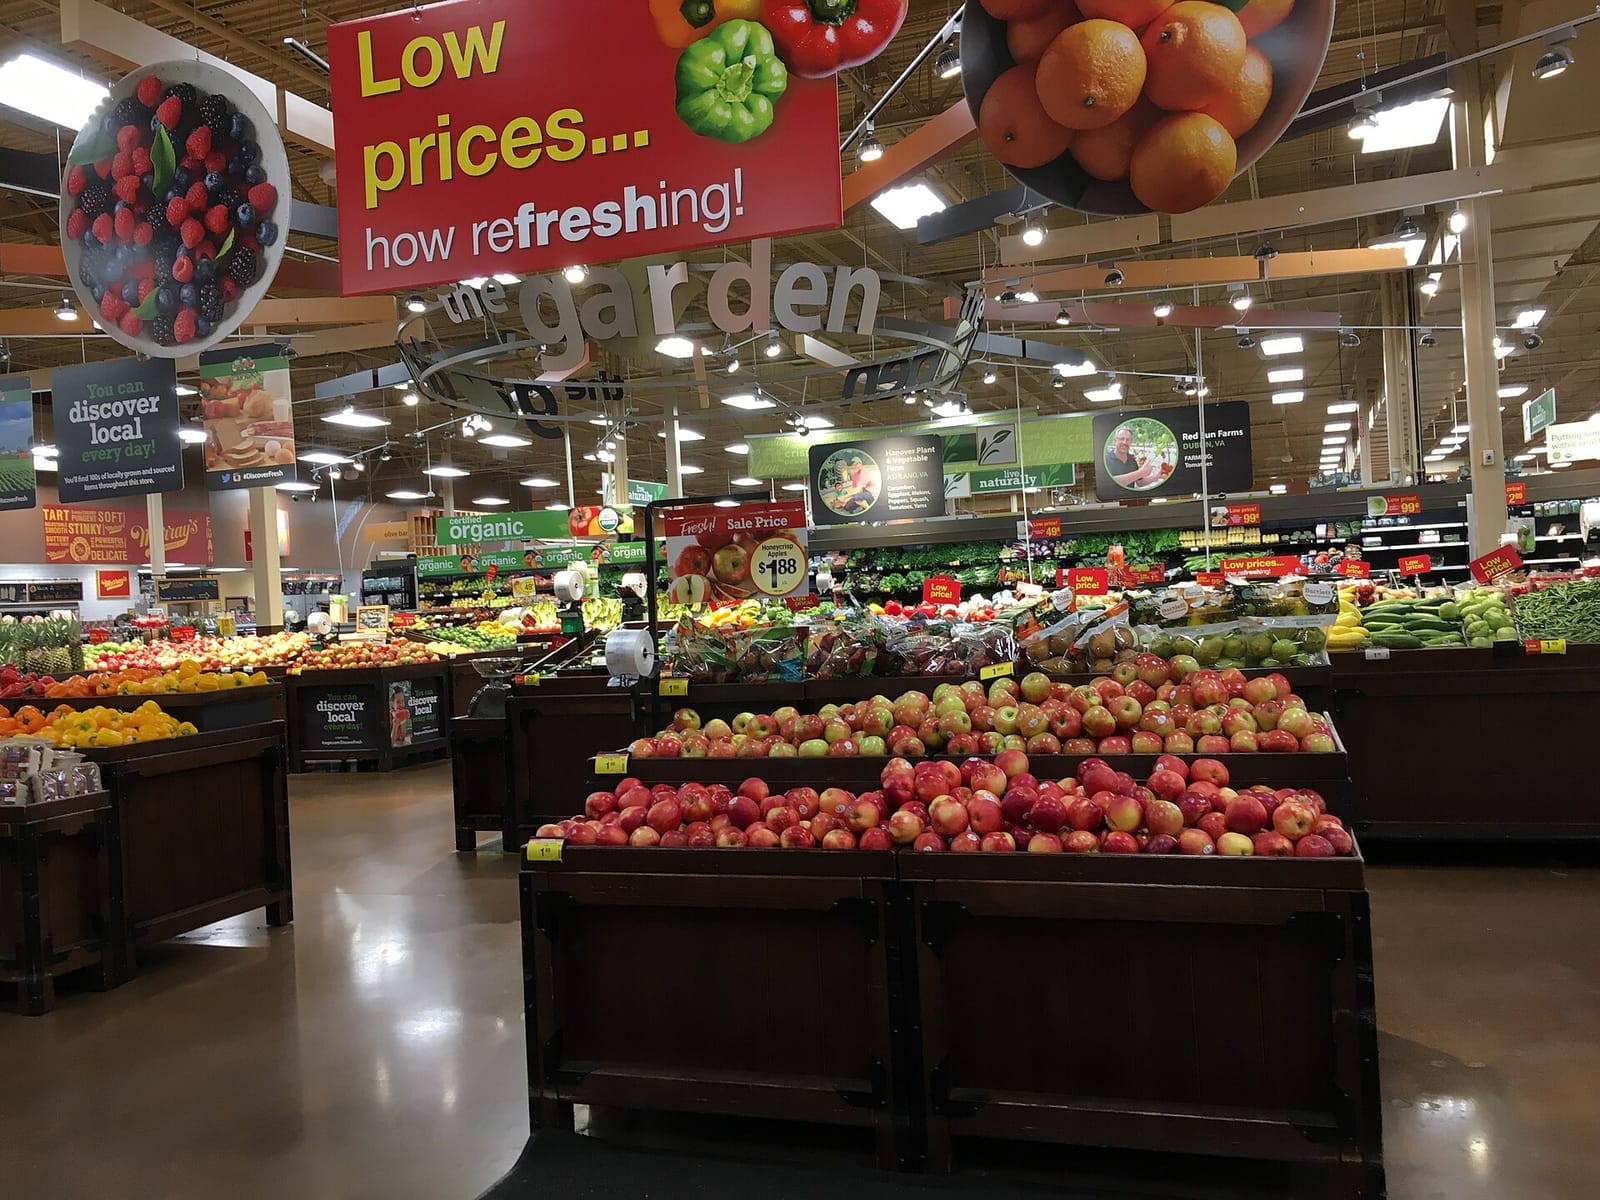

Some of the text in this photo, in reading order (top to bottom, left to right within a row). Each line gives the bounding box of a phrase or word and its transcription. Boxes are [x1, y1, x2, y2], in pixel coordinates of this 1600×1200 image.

[358, 20, 506, 98] Low
[363, 107, 650, 209] prices...
[365, 168, 745, 271] how refreshing!
[440, 238, 881, 372] the garden
[86, 381, 145, 399] You can
[69, 396, 160, 424] discover
[89, 417, 143, 445] local
[1182, 431, 1199, 441] Red
[1217, 429, 1244, 438] Farms
[81, 440, 156, 464] every day!
[885, 446, 936, 457] Hanover Plant
[892, 454, 928, 465] Vegetable
[142, 467, 153, 475] and
[919, 471, 929, 479] VA
[1003, 470, 1020, 478] live
[42, 508, 70, 521] TART
[97, 511, 123, 523] SOFT
[449, 516, 482, 526] certified
[680, 516, 788, 537] Fresh! Sale Price
[68, 523, 102, 535] STINKY
[384, 530, 398, 538] olive
[449, 517, 524, 542] organic
[613, 543, 646, 559] organi
[761, 543, 794, 551] Honeycrisp
[91, 550, 128, 561] DELICATE
[546, 552, 584, 563] organic
[767, 550, 788, 558] Apples
[418, 560, 454, 571] organic
[1223, 559, 1285, 569] Low prices...
[1405, 563, 1425, 571] price!
[1480, 556, 1502, 570] Low
[1484, 558, 1512, 578] price!
[930, 583, 948, 591] Low
[1075, 581, 1099, 590] price!
[930, 591, 952, 599] price!
[327, 692, 342, 701] You
[407, 695, 438, 707] discover
[316, 700, 365, 712] discover
[414, 704, 433, 715] local
[327, 711, 356, 722] local
[323, 722, 364, 732] every day!
